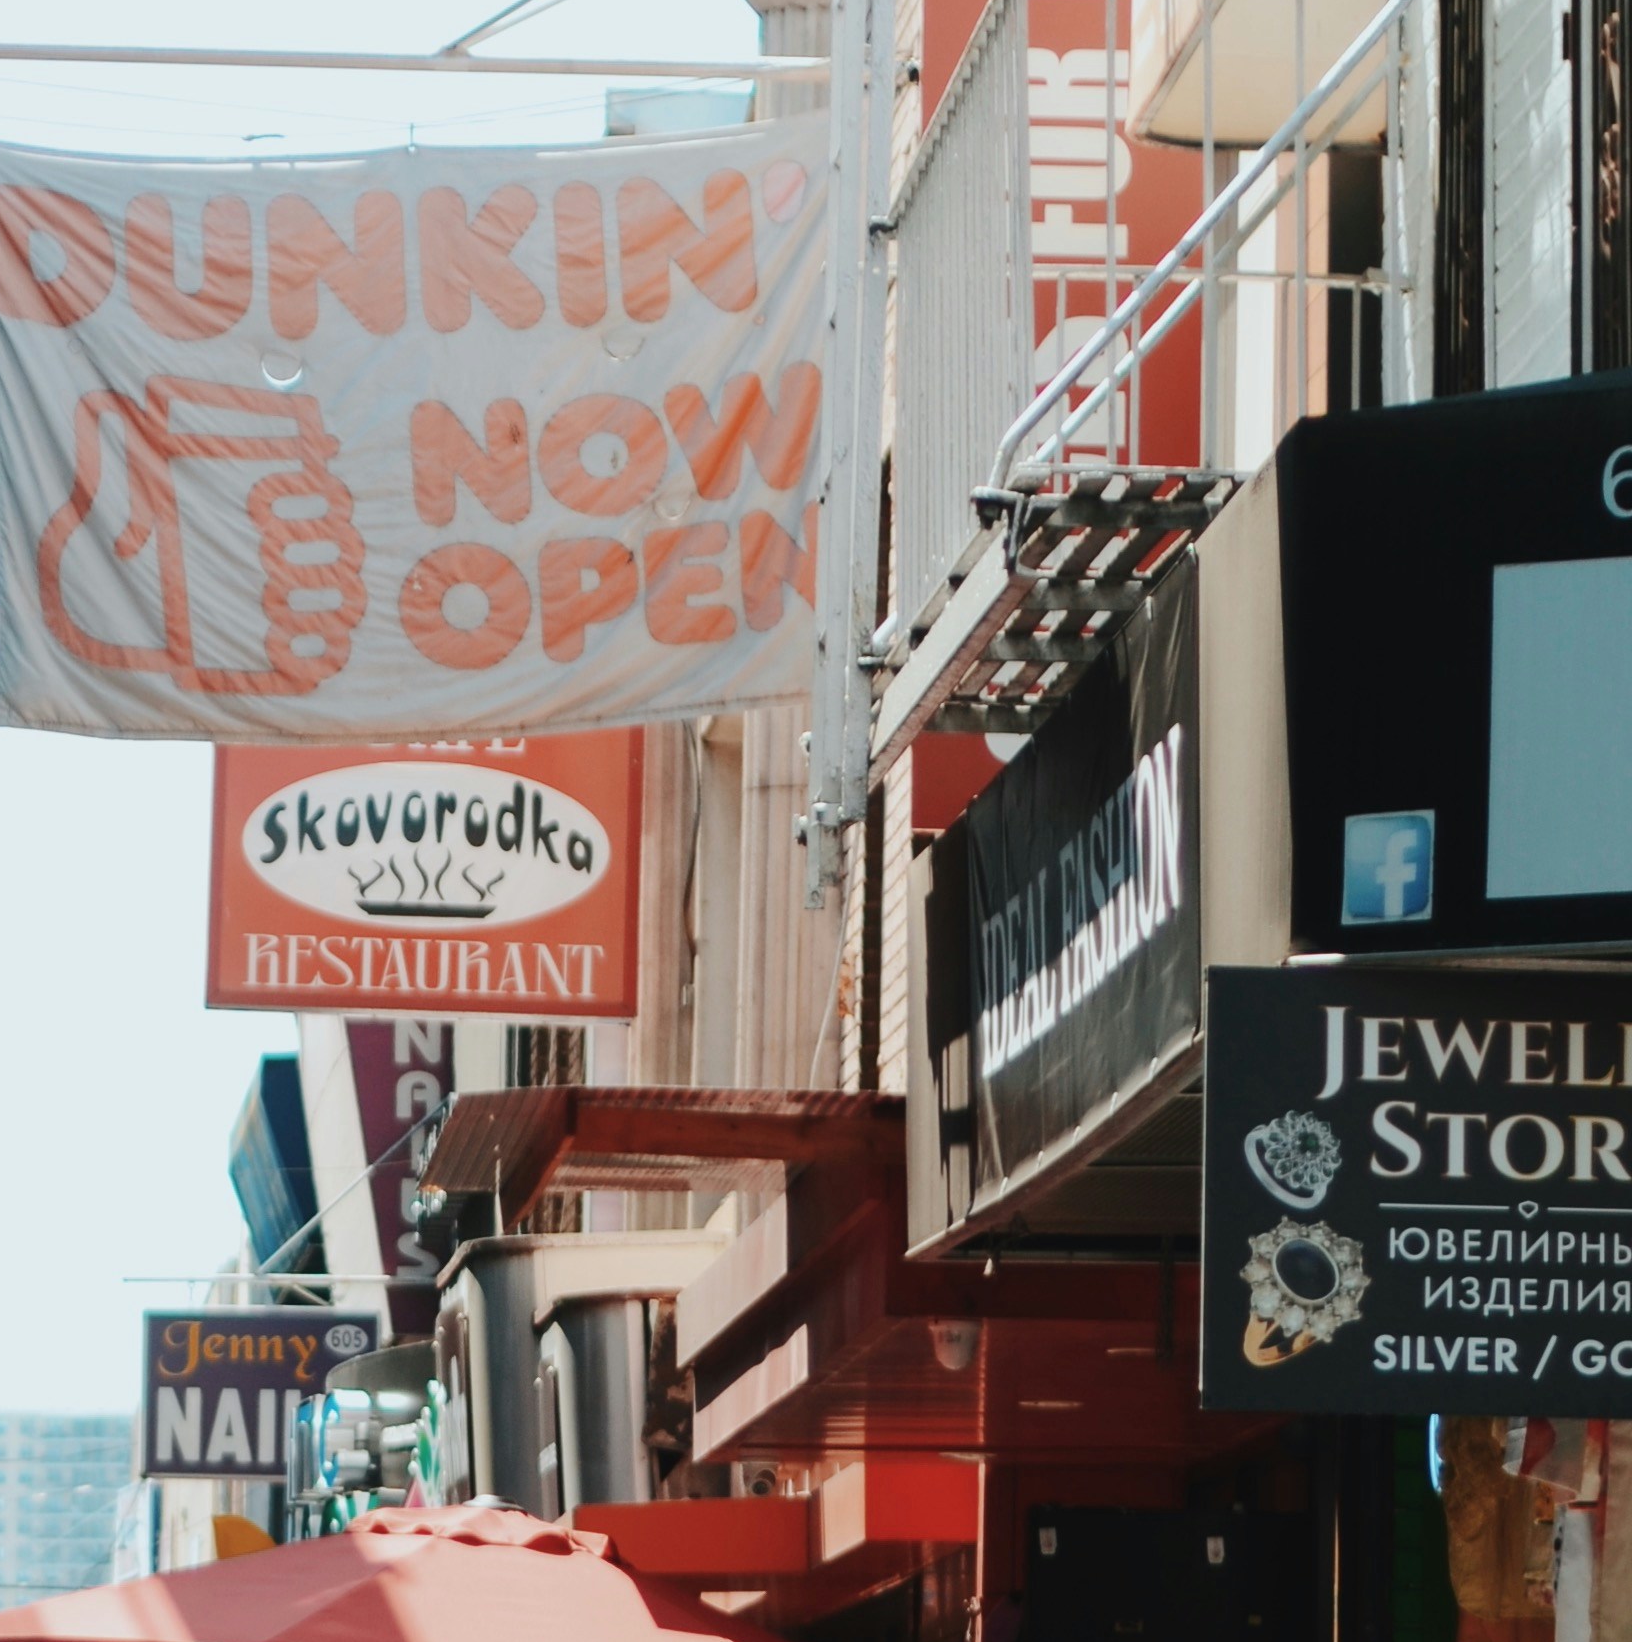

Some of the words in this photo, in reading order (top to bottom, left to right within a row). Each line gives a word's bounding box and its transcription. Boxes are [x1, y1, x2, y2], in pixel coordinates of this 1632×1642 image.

[409, 360, 823, 527] NOW
[398, 502, 818, 670] OPEN
[980, 866, 1057, 1079] IDEAL
[1059, 721, 1183, 1019] FASHION
[242, 932, 604, 1000] RESTAURANT
[158, 1320, 318, 1384] Jenny
[331, 1330, 363, 1348] 605
[1373, 1335, 1518, 1372] SILVER
